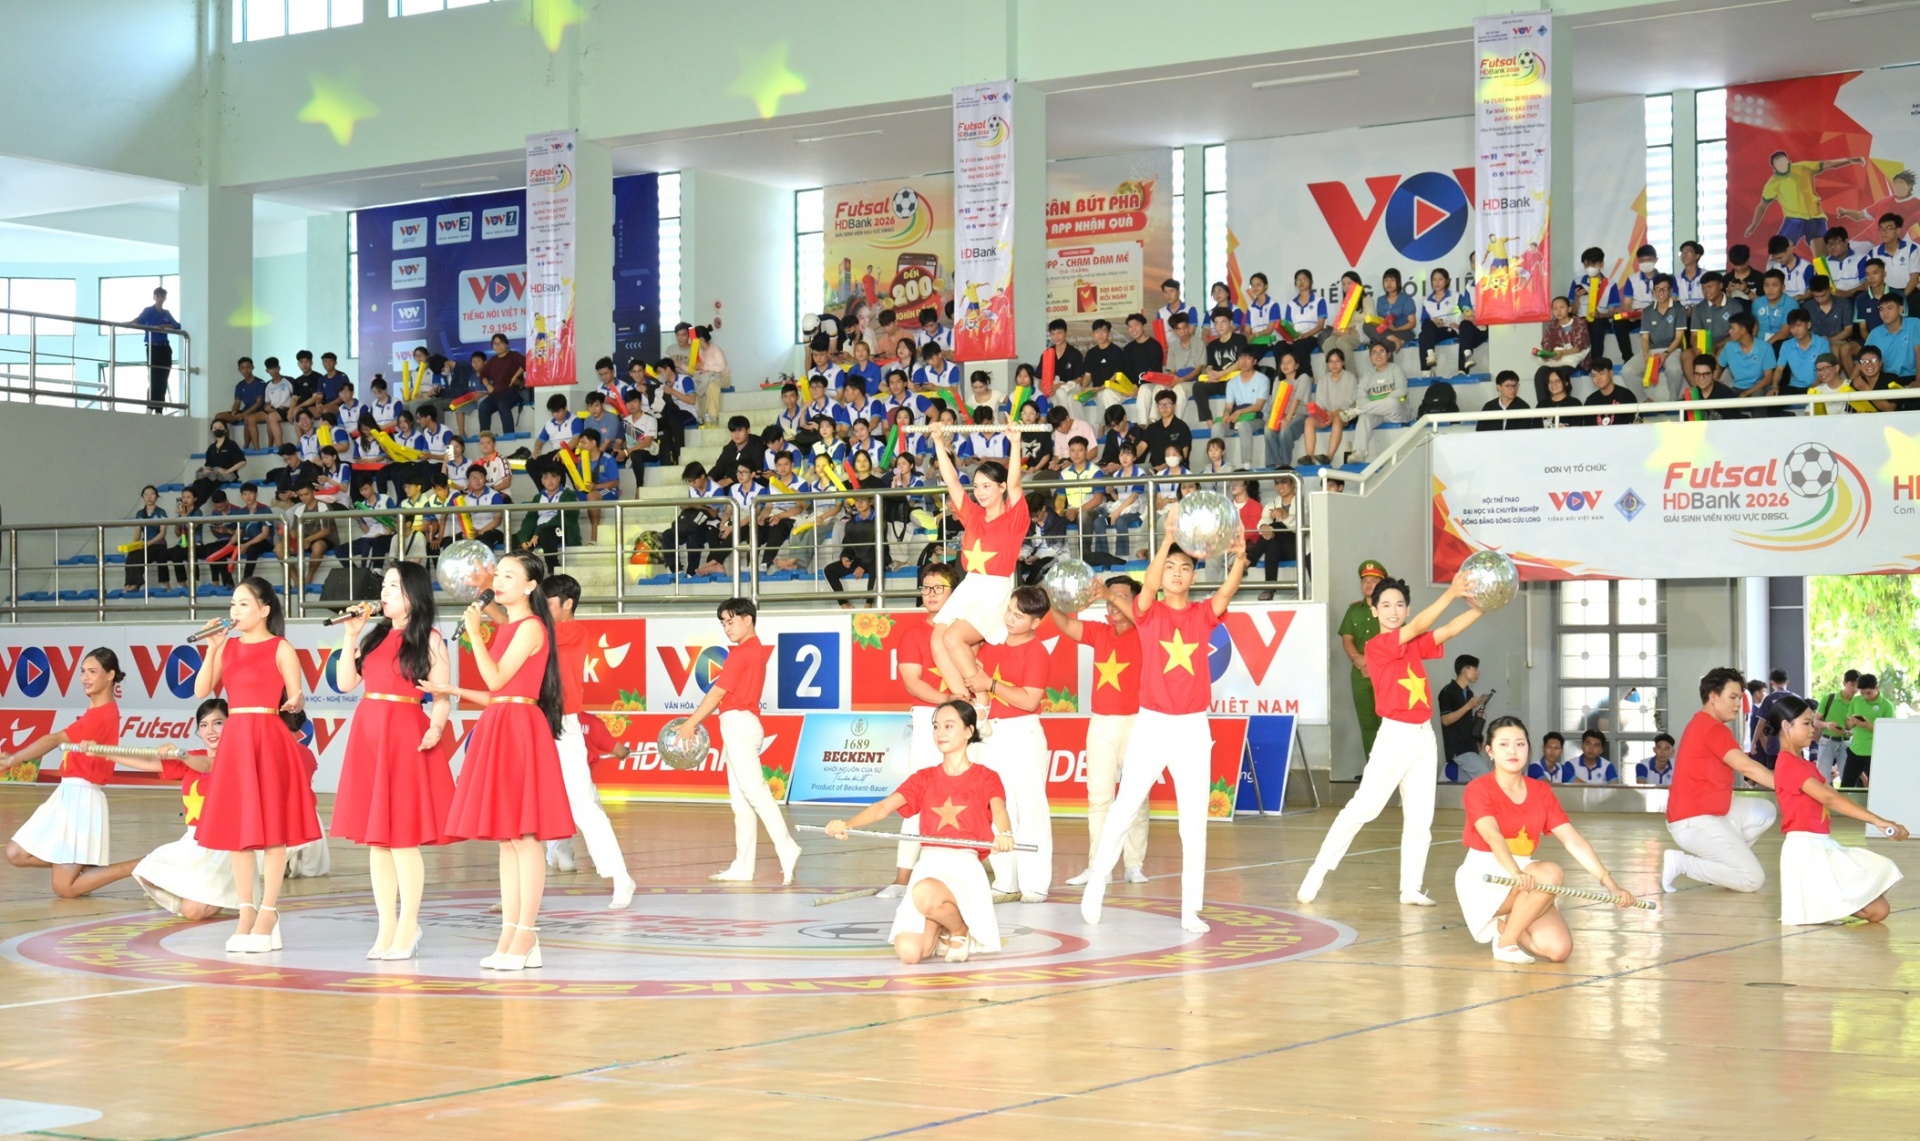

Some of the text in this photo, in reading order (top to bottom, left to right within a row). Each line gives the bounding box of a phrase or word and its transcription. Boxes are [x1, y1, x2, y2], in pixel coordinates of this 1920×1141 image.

[1480, 56, 1516, 68] Futsal
[957, 120, 986, 131] Futsal
[836, 198, 890, 218] Futsal
[1076, 194, 1106, 213] BÚT
[1109, 190, 1140, 210] PHÁ
[1482, 197, 1531, 211] HDBank
[485, 214, 506, 226] VOV
[835, 216, 896, 230] HDBank 2026
[1052, 214, 1134, 234] APP NHẬN QUÀ
[1307, 167, 1476, 268] VO
[400, 224, 420, 236] VOV
[438, 218, 468, 231] VOV 3
[961, 246, 996, 260] HDBank
[398, 264, 420, 276] VOV
[903, 268, 920, 279] ĐẾN
[892, 275, 933, 308] 200
[398, 306, 420, 320] VOV
[463, 308, 484, 321] TIẾNG
[486, 309, 499, 320] NÓI
[502, 306, 518, 319] VIỆT
[482, 322, 518, 334] 7.9.1945
[1544, 462, 1607, 474] ĐƠN VỊ TỔ CHỨC
[1664, 458, 1778, 490] Futsal
[1548, 490, 1603, 512] VOV
[1664, 491, 1790, 510] HDBank 2026
[1496, 506, 1518, 514] CHUYÊN
[1894, 506, 1916, 514] Cam
[1664, 514, 1680, 522] GIẢI
[1703, 512, 1722, 522] VIÊN
[1743, 512, 1760, 522] VỰC
[1762, 512, 1789, 520] ĐBSCL
[795, 644, 822, 698] 2
[664, 701, 694, 710] VĂN HÓA
[1258, 700, 1298, 713] NAM
[120, 716, 195, 738] Futsal
[844, 738, 870, 750] 1689
[822, 751, 886, 764] BECKENT
[844, 784, 888, 792] Beckent-Bauer
[324, 977, 638, 994] 2026
[664, 966, 1116, 994] HDBANK
